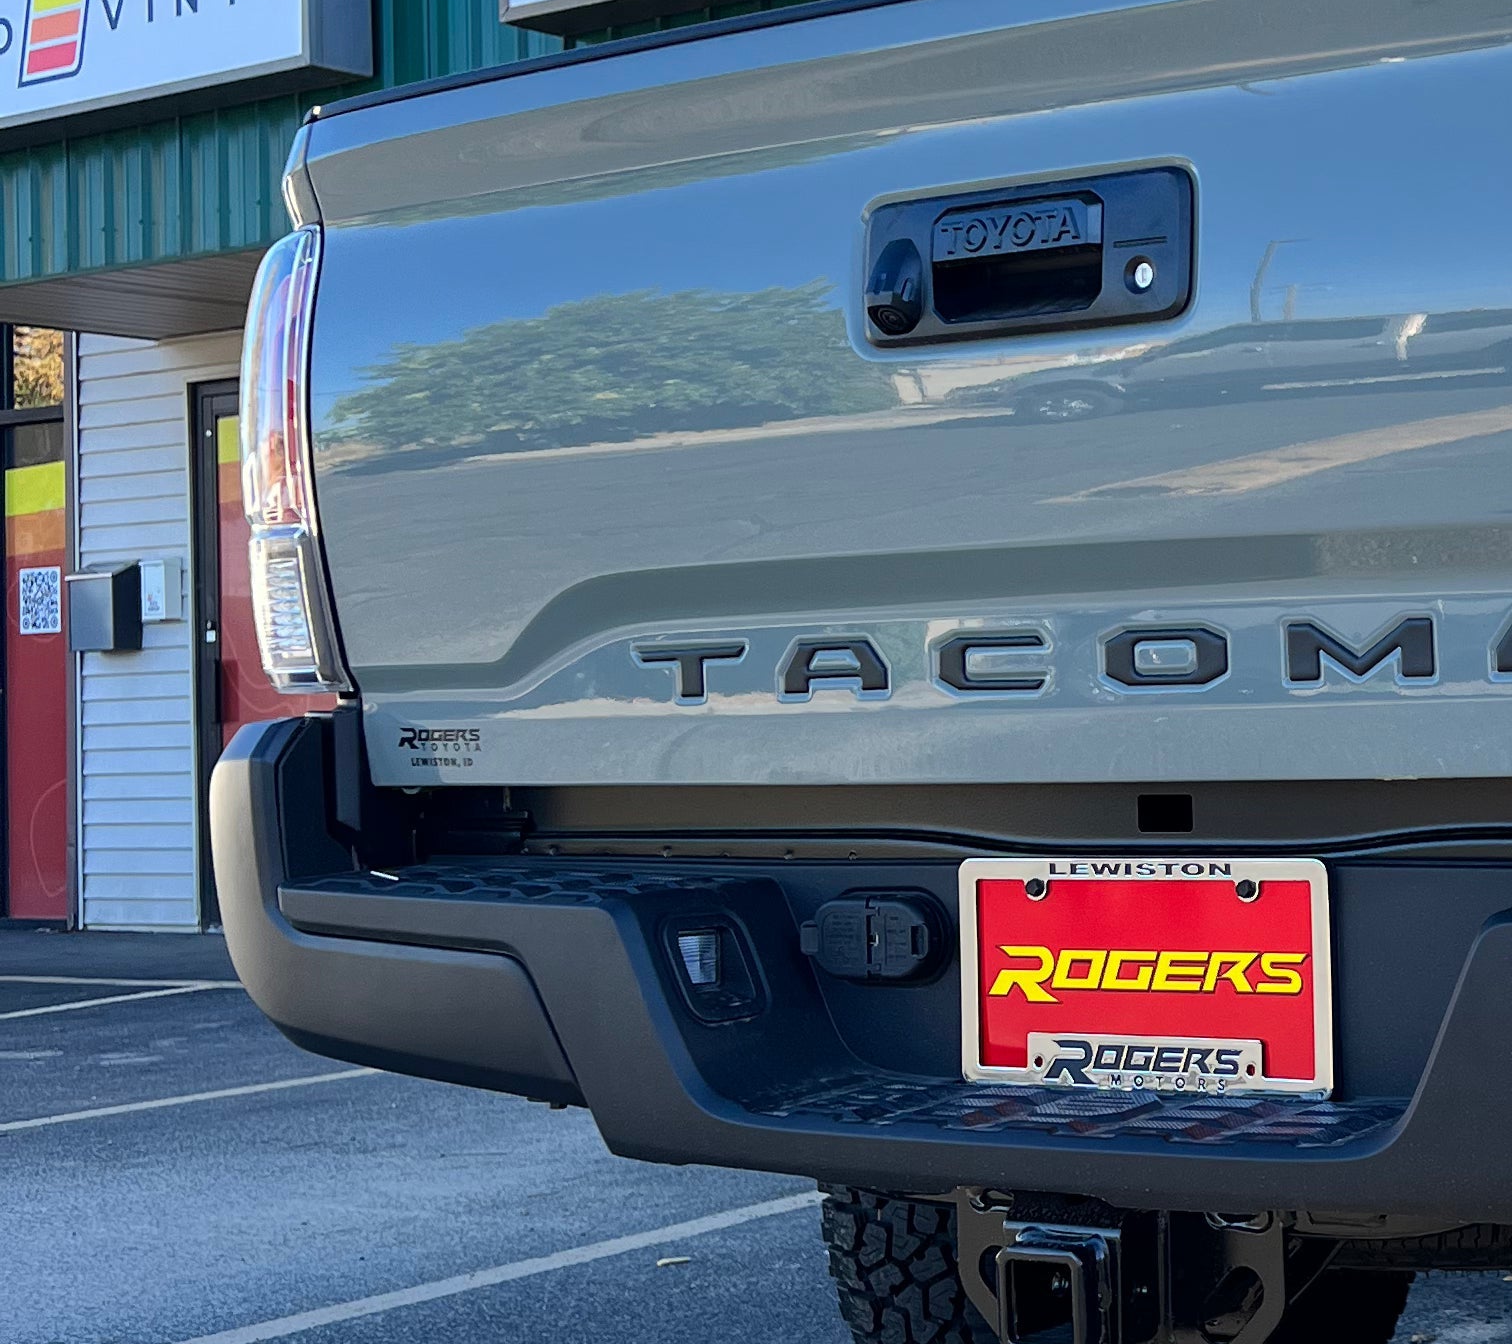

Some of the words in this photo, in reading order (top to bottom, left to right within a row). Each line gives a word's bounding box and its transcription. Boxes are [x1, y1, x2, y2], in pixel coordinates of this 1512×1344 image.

[940, 206, 1082, 256] TOYOTA
[398, 727, 480, 750] ROGERS
[420, 742, 482, 752] TOYOTA
[463, 757, 474, 767] ID
[1048, 862, 1233, 878] LEWISTON
[988, 945, 1307, 1003] ROGERS
[1042, 1039, 1245, 1085] ROGERS
[1108, 1072, 1227, 1092] MOTORS
